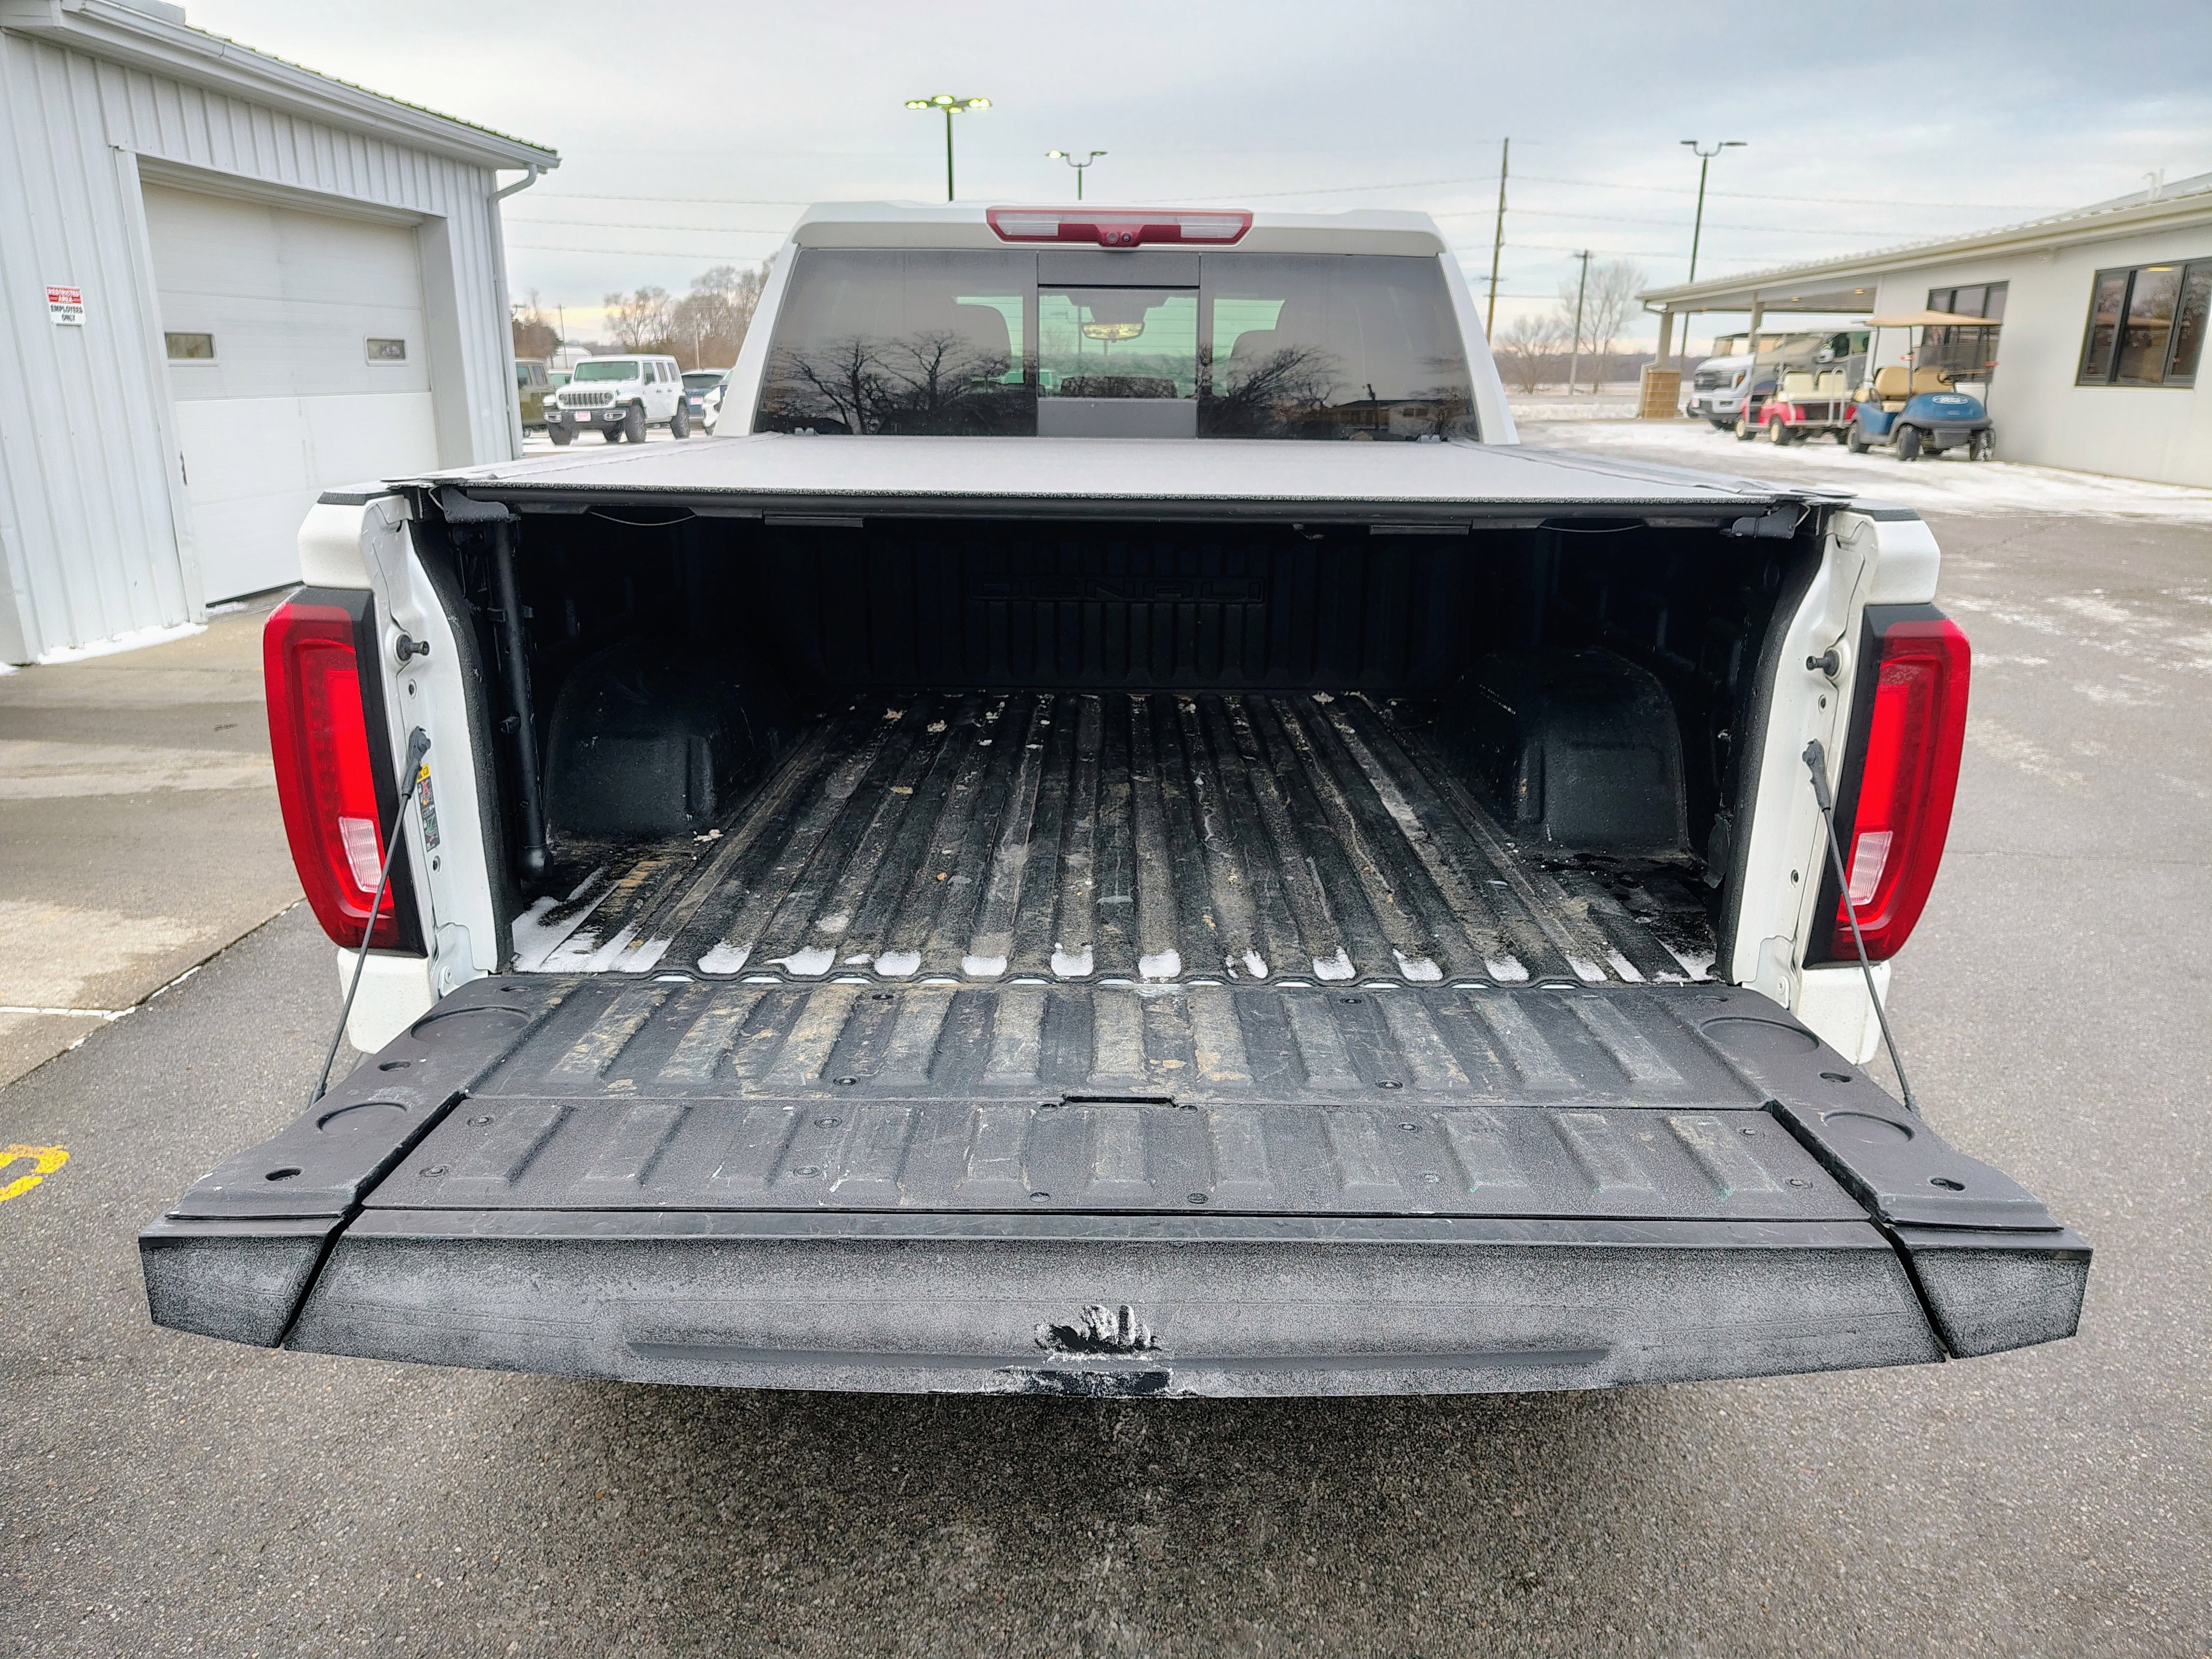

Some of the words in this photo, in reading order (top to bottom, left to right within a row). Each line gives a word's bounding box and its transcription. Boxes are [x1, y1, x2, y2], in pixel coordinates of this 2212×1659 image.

[50, 304, 83, 314] EMPLOYEES
[62, 314, 76, 322] ONLY
[972, 577, 1266, 603] DENALI
